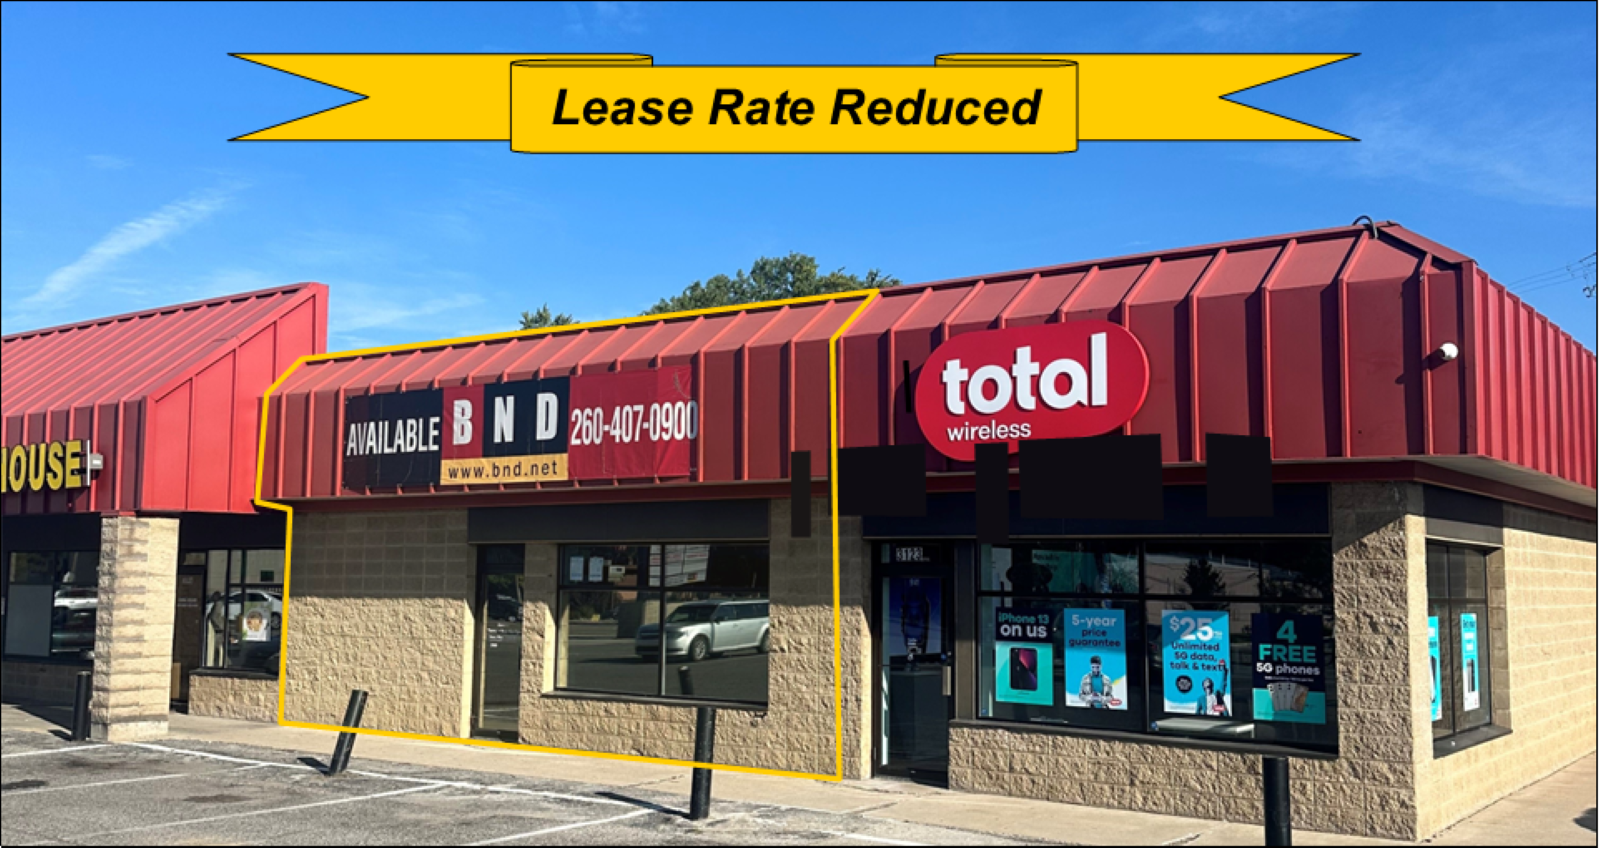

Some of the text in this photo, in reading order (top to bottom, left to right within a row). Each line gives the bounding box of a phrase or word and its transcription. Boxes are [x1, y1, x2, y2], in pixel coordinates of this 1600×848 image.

[942, 331, 1108, 415] total
[570, 400, 699, 446] 260-407-0900
[947, 420, 1032, 441] wireless
[346, 416, 441, 456] AVAILABLE
[448, 461, 558, 479] www.bnd.net
[999, 612, 1050, 625] iPhone 13
[1071, 614, 1117, 628] 5-year
[1000, 624, 1047, 638] on us
[1081, 628, 1107, 638] price
[1169, 615, 1214, 641] $25
[1276, 619, 1297, 643] 4
[1068, 638, 1121, 648] guarantee
[1171, 641, 1220, 652] Unlimited
[1259, 643, 1316, 663] FREE
[1170, 661, 1189, 670] talk
[1256, 662, 1320, 675] 5G phones
